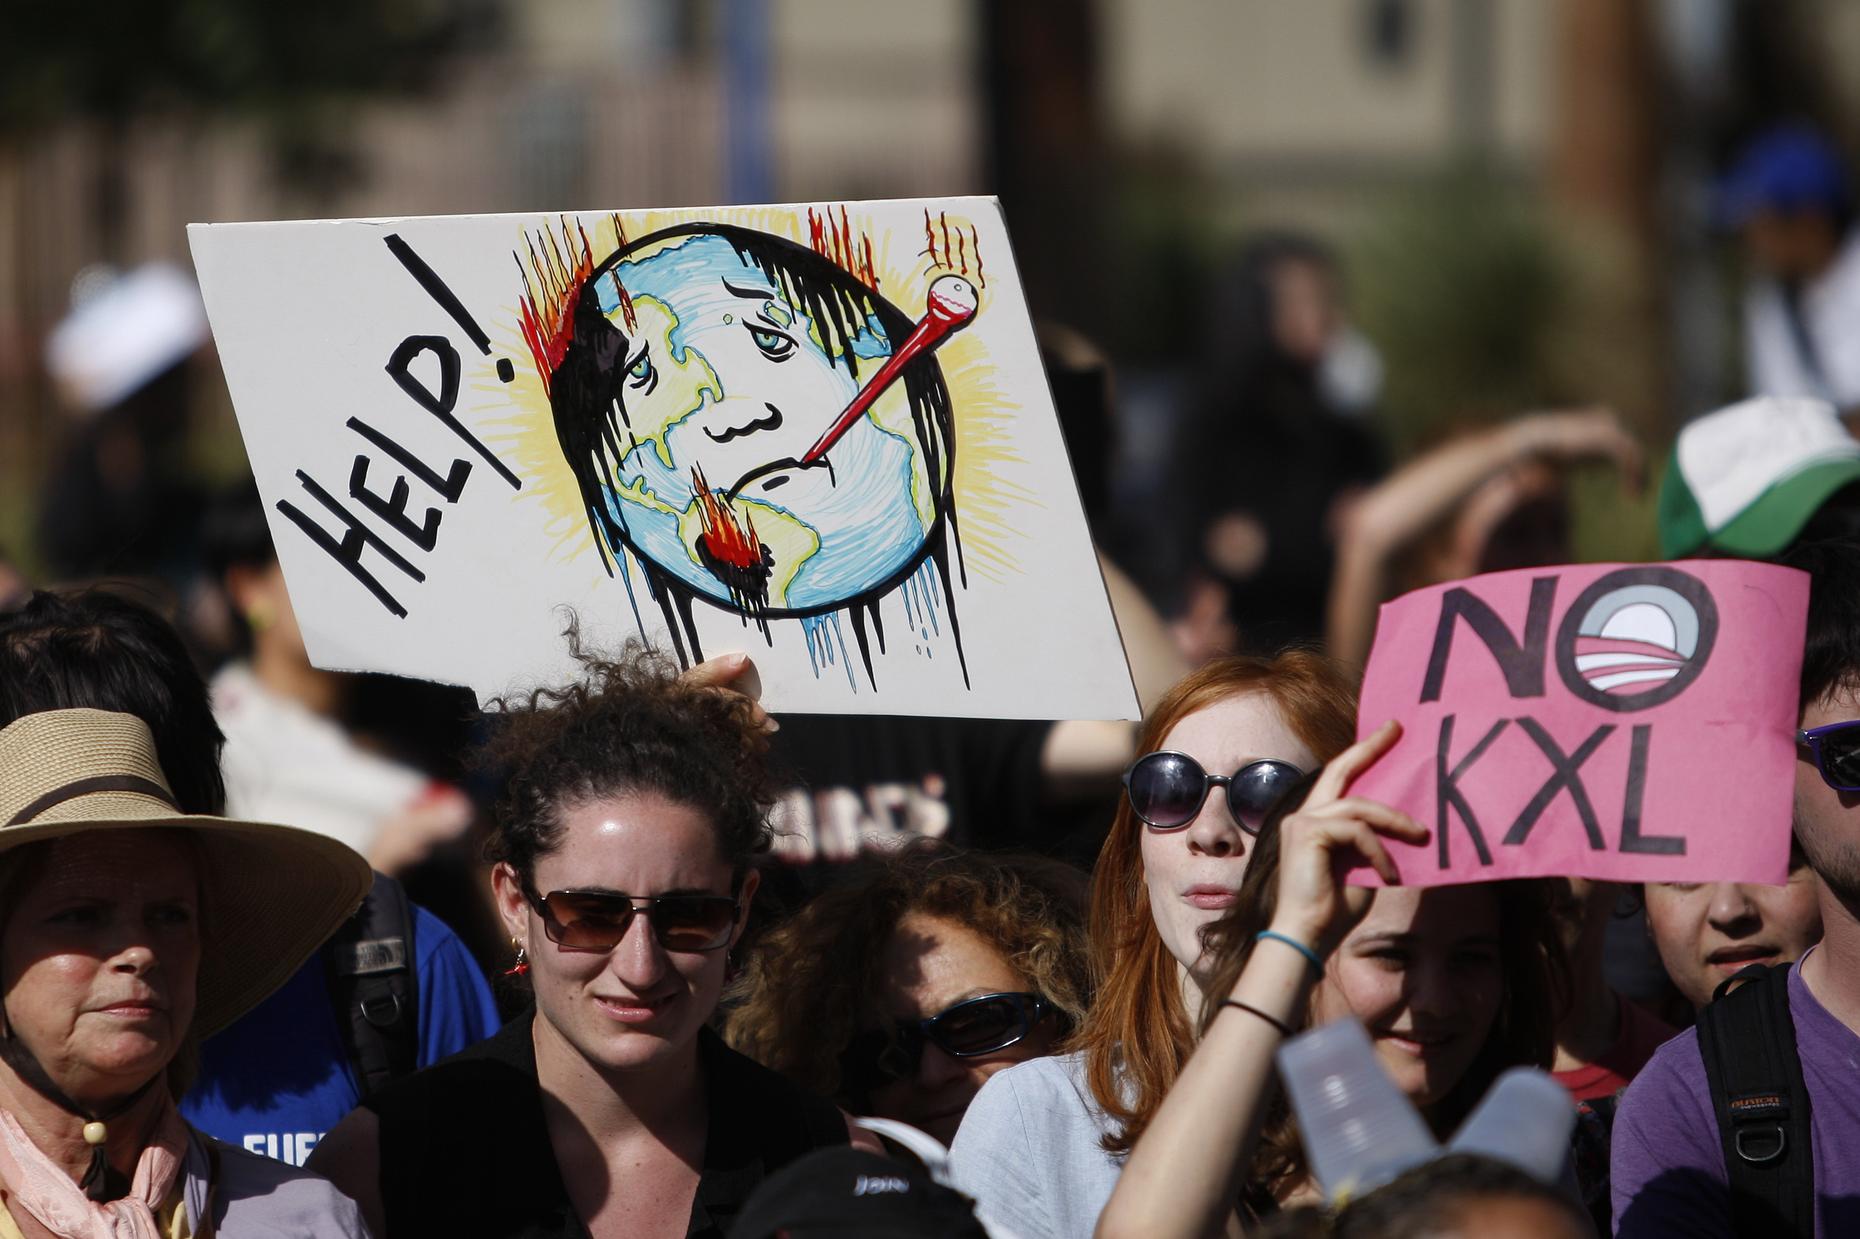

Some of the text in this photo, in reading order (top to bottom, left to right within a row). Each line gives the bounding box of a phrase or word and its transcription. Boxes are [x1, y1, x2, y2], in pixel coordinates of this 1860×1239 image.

[275, 233, 522, 619] HELP!
[1419, 566, 1720, 713] NO
[1436, 713, 1688, 870] KXL
